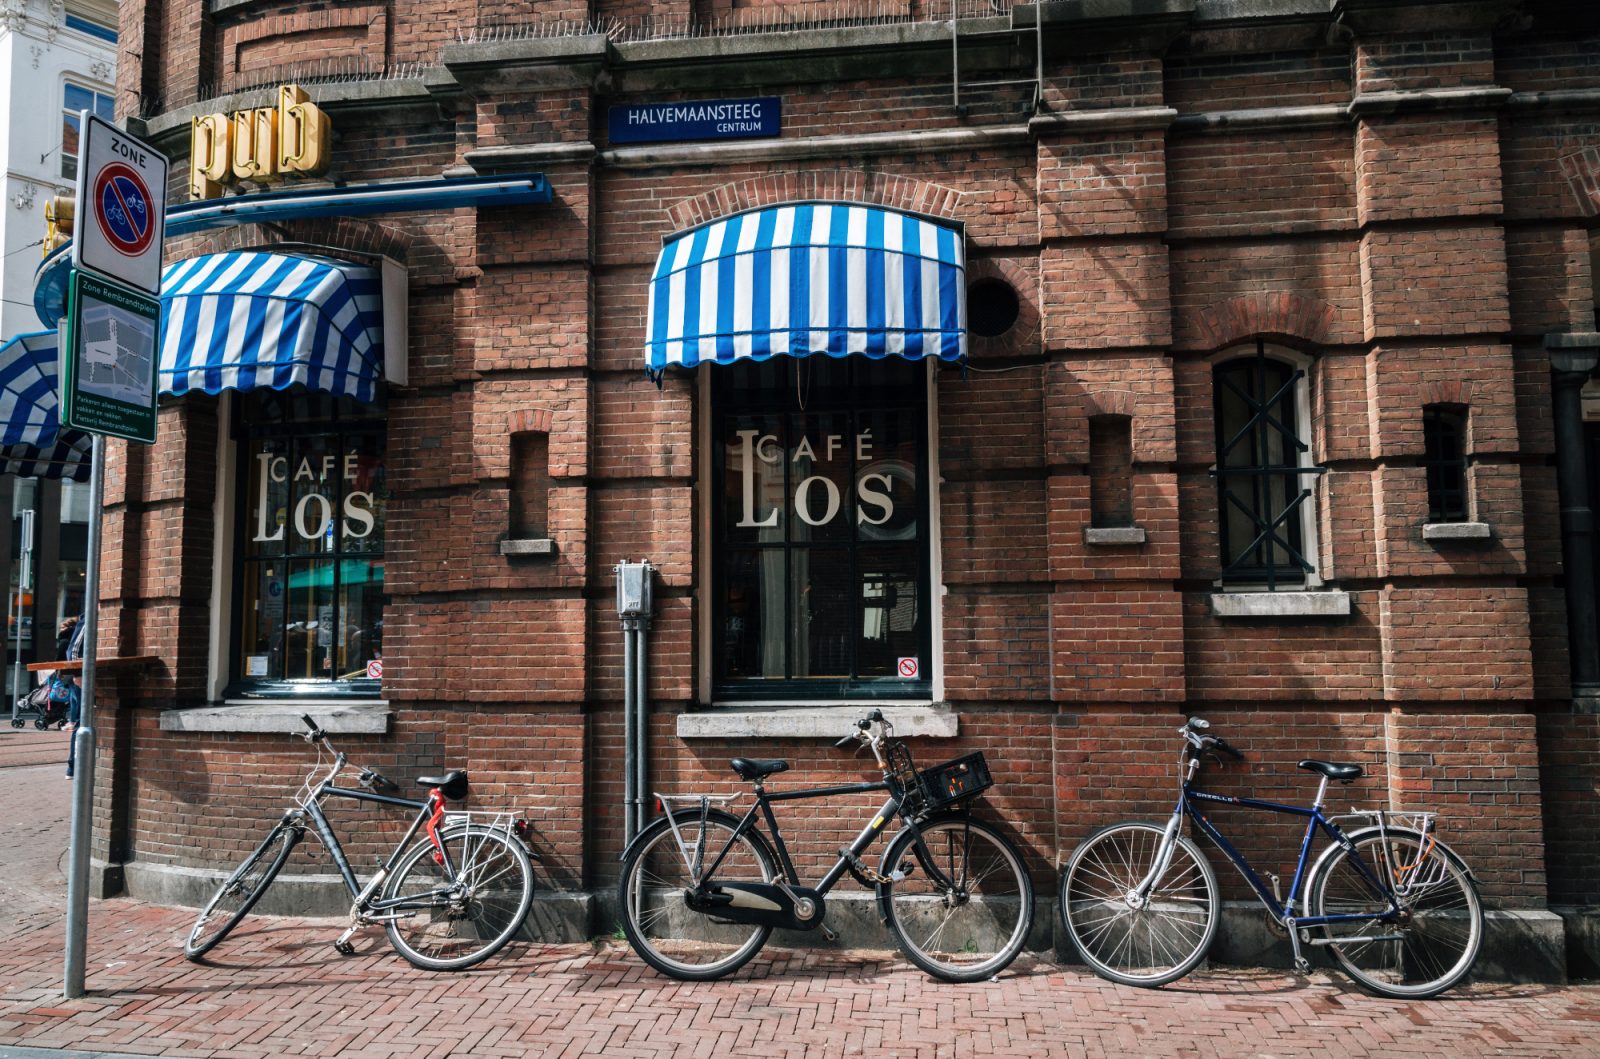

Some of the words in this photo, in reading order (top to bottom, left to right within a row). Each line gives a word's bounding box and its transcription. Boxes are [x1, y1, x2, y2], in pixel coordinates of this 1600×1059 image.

[628, 103, 761, 125] HALVEMAANSTEEG
[717, 122, 761, 133] CENTRUM
[111, 137, 147, 169] ZONE
[189, 84, 330, 200] pub
[82, 280, 101, 295] Zone
[103, 287, 156, 315] Rembrandtplein
[756, 428, 873, 463] CAFÉ
[270, 449, 359, 482] CAFÉ
